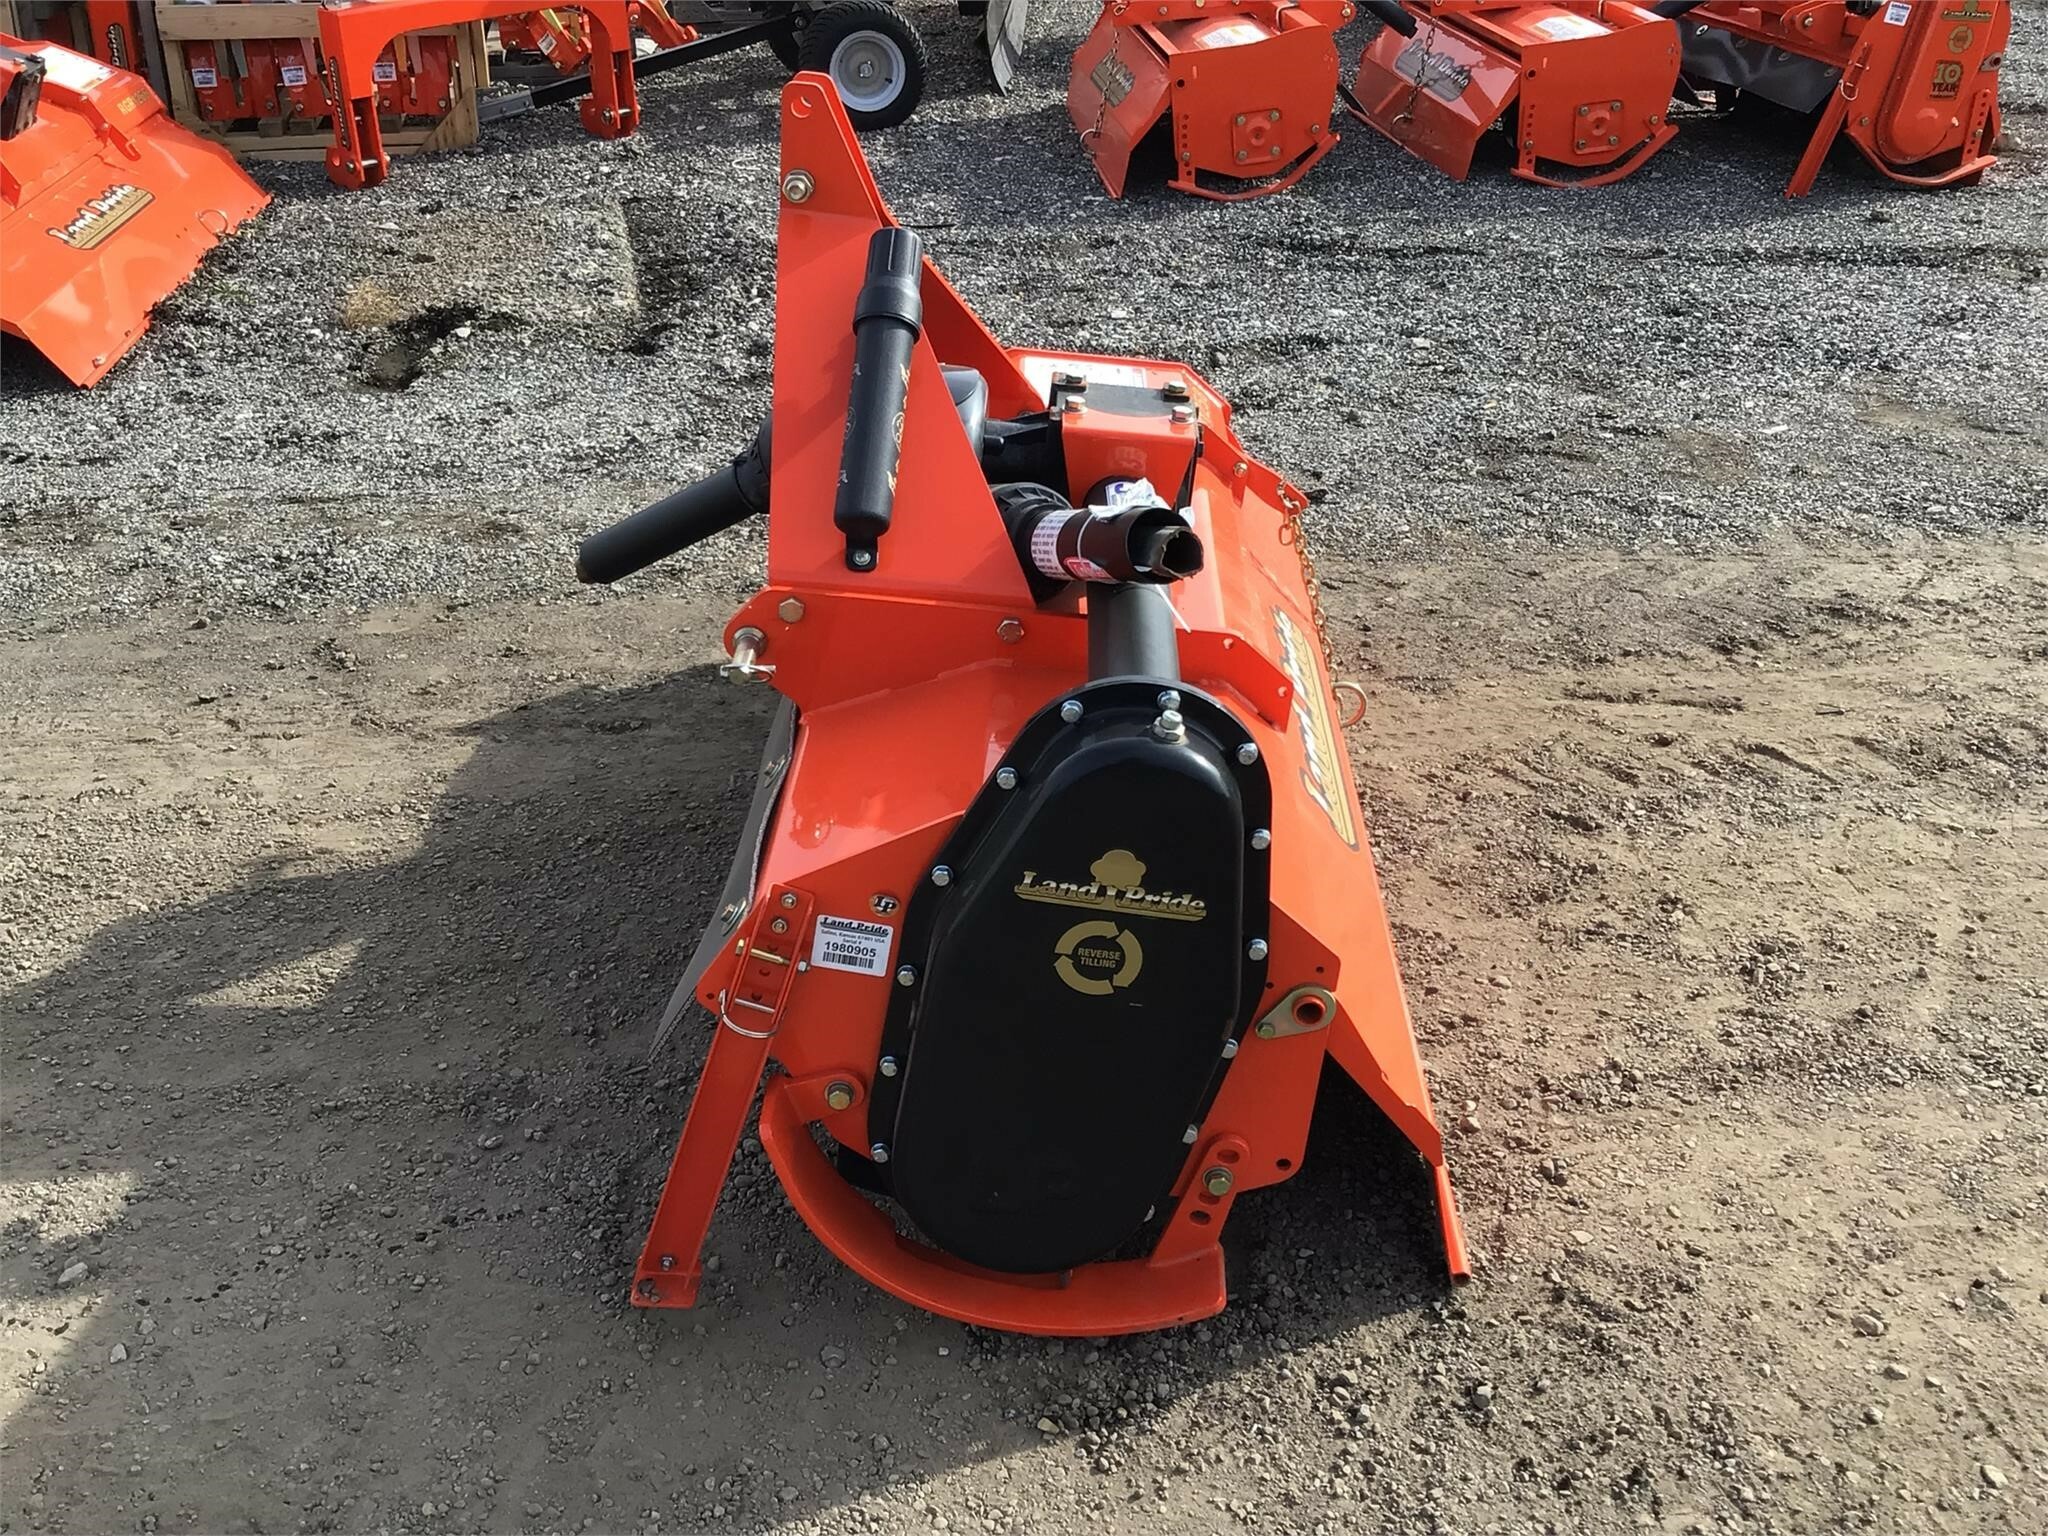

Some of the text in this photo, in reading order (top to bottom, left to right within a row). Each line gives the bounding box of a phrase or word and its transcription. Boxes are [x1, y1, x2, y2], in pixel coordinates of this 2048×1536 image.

[1934, 63, 1961, 84] 10
[1932, 82, 1956, 92] YEAR
[47, 184, 140, 248] Land Pride
[1016, 870, 1207, 915] Land Pride
[874, 896, 897, 913] LP
[820, 916, 889, 937] Land Pride
[824, 941, 877, 958] 1980905
[1077, 947, 1122, 961] REVERSE
[1080, 956, 1117, 969] TILLING
